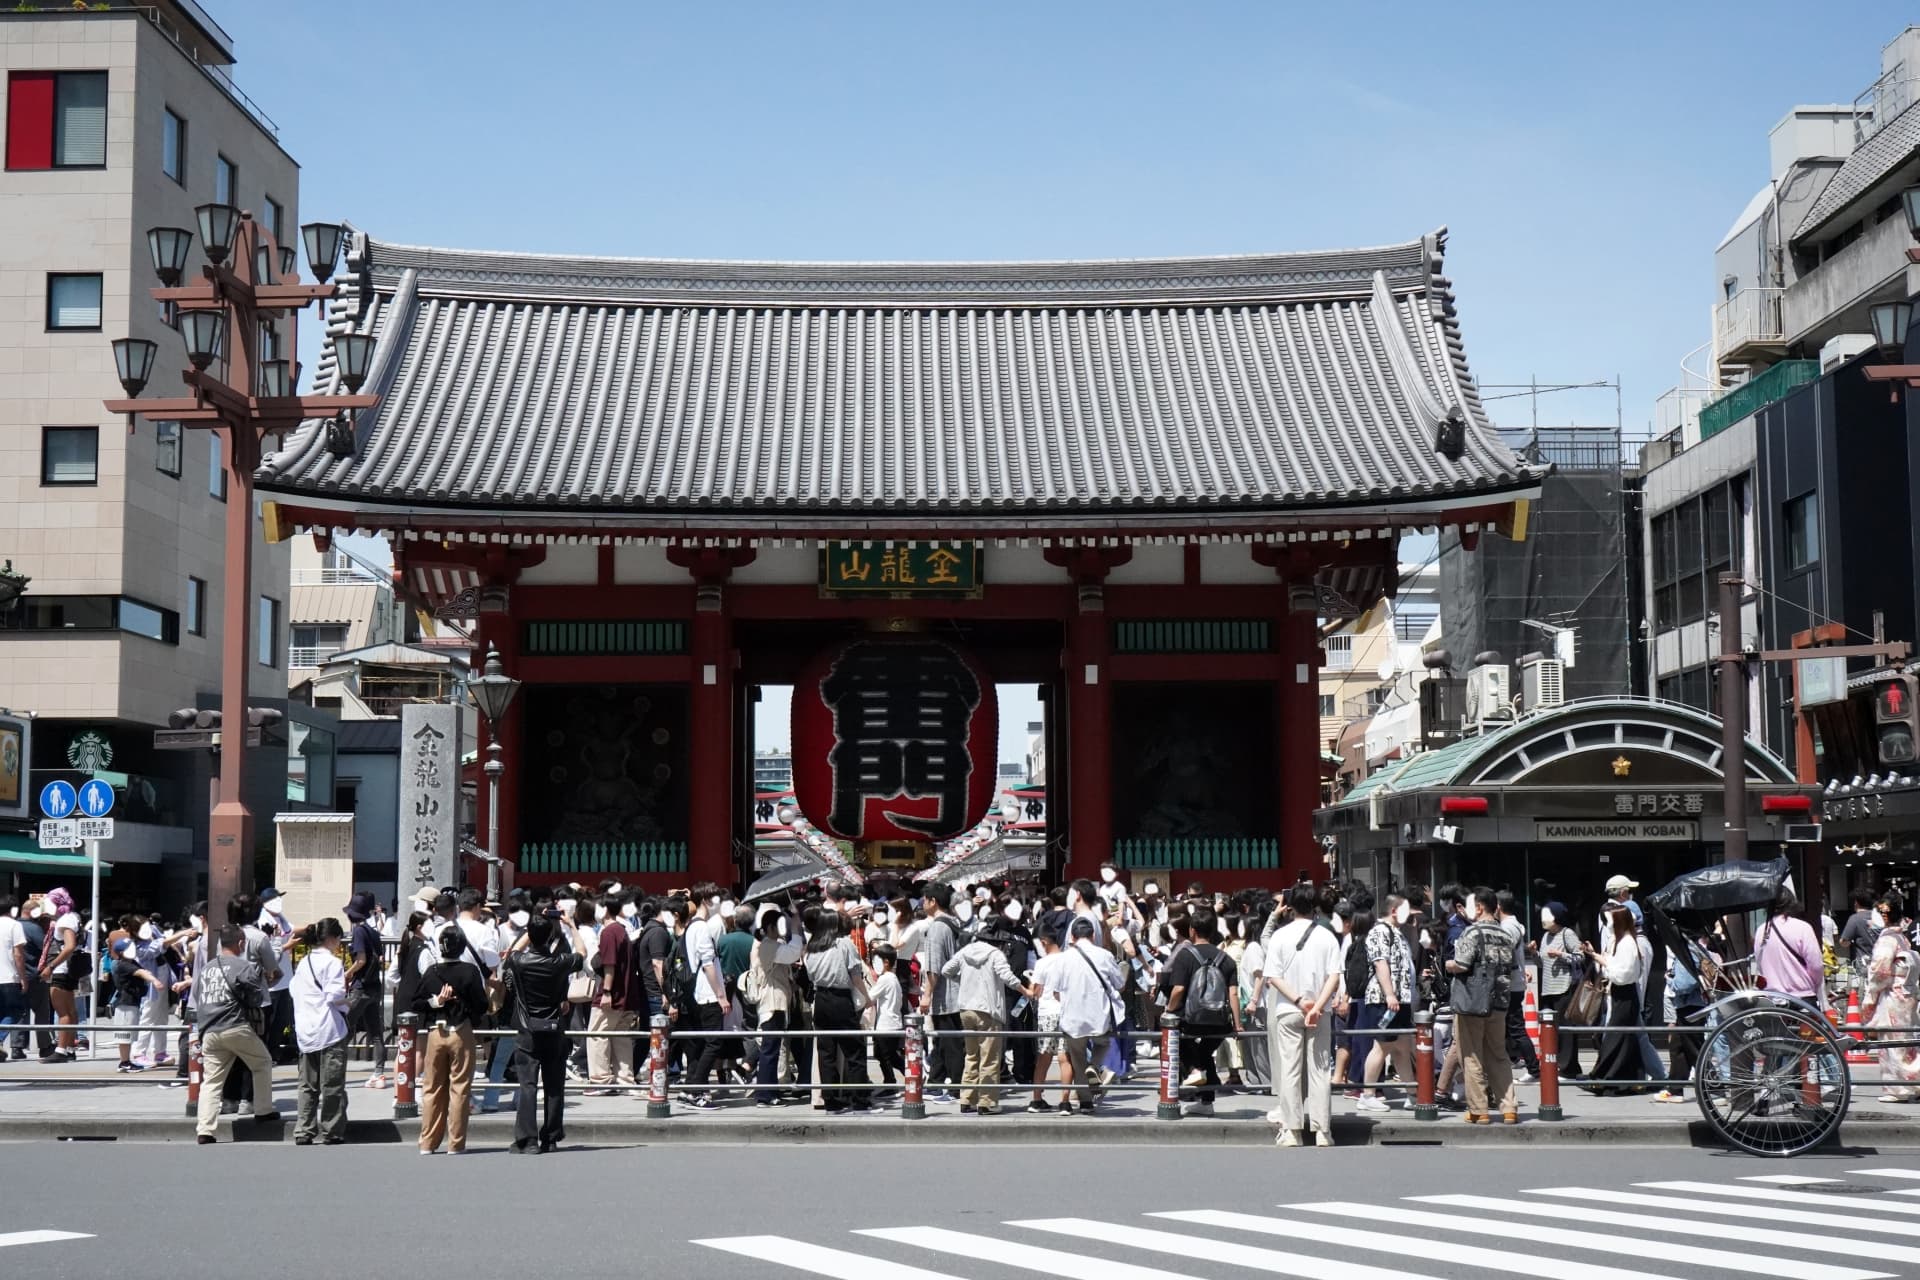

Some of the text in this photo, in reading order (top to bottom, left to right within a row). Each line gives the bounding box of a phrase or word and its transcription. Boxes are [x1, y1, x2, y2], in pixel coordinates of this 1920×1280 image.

[819, 640, 982, 839] 雷門
[1614, 793, 1704, 814] 雷門交番
[1545, 824, 1686, 838] KAMINARIMON KOBAN
